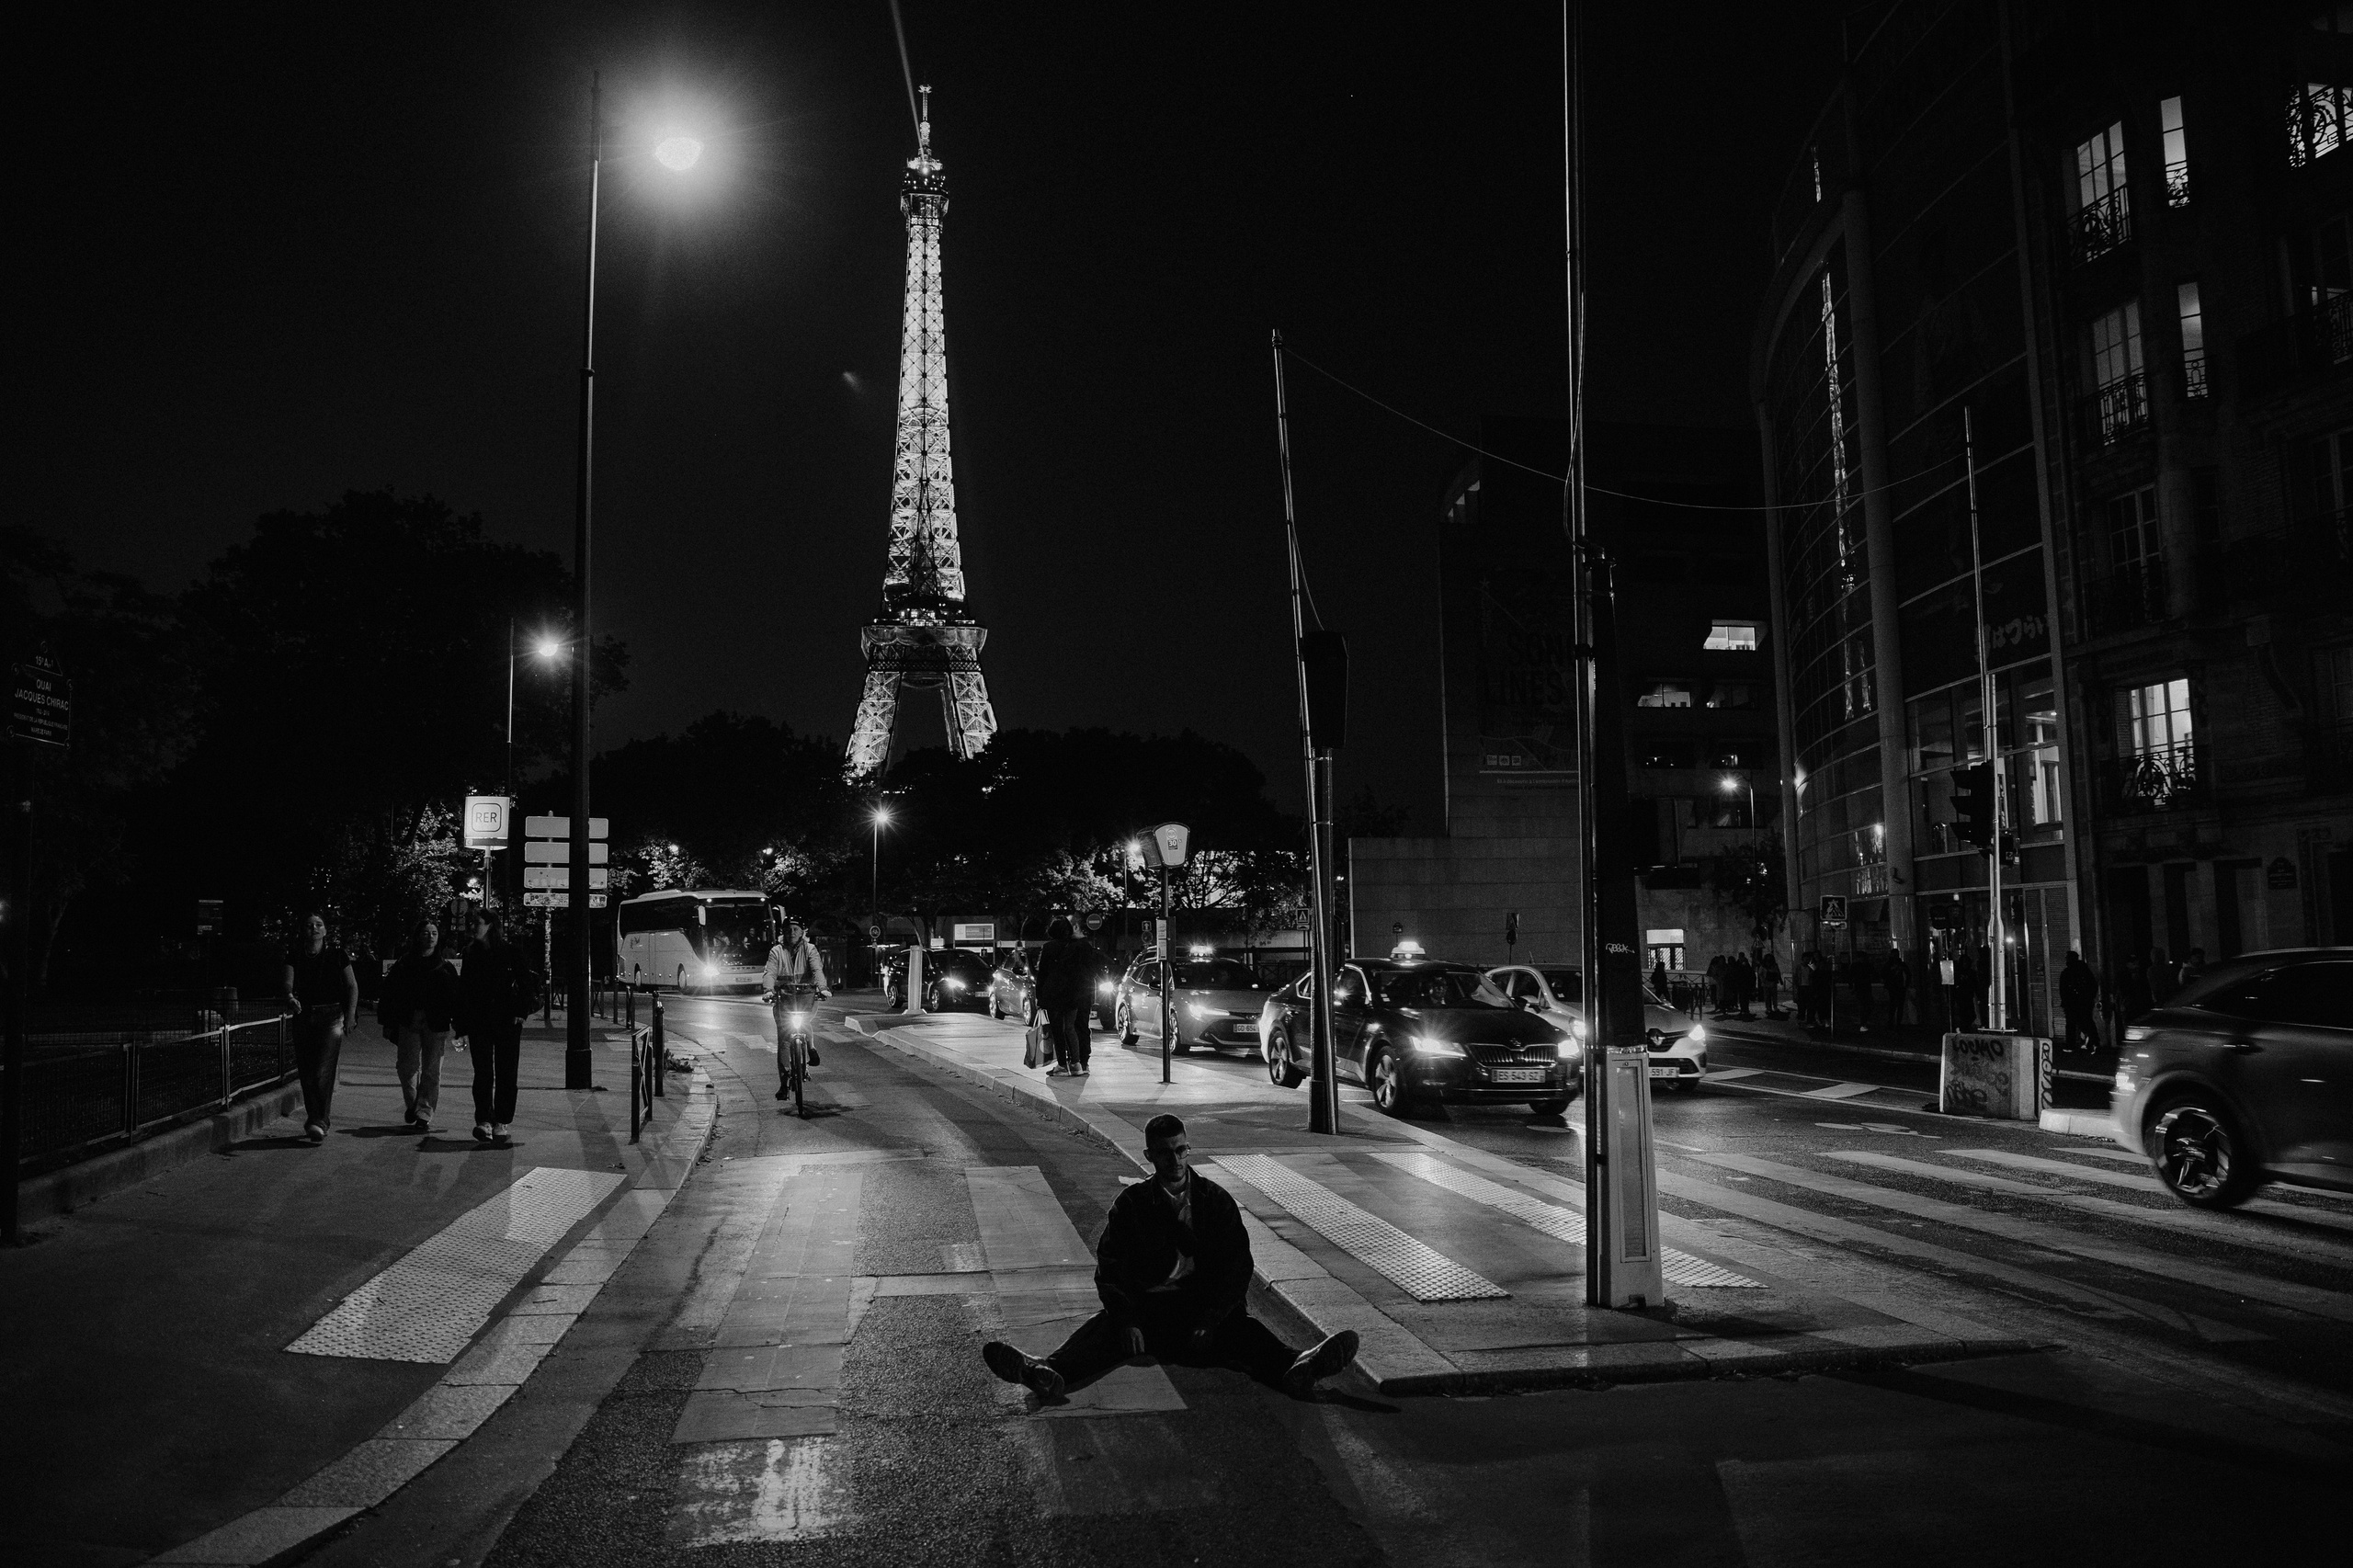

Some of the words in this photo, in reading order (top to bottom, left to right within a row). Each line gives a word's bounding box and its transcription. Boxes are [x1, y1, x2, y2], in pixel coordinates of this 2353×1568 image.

[36, 679, 51, 692] QUAI
[15, 688, 46, 704] JACQUES
[46, 696, 69, 710] CHIRAC
[476, 812, 497, 824] RER
[1168, 839, 1177, 847] 30
